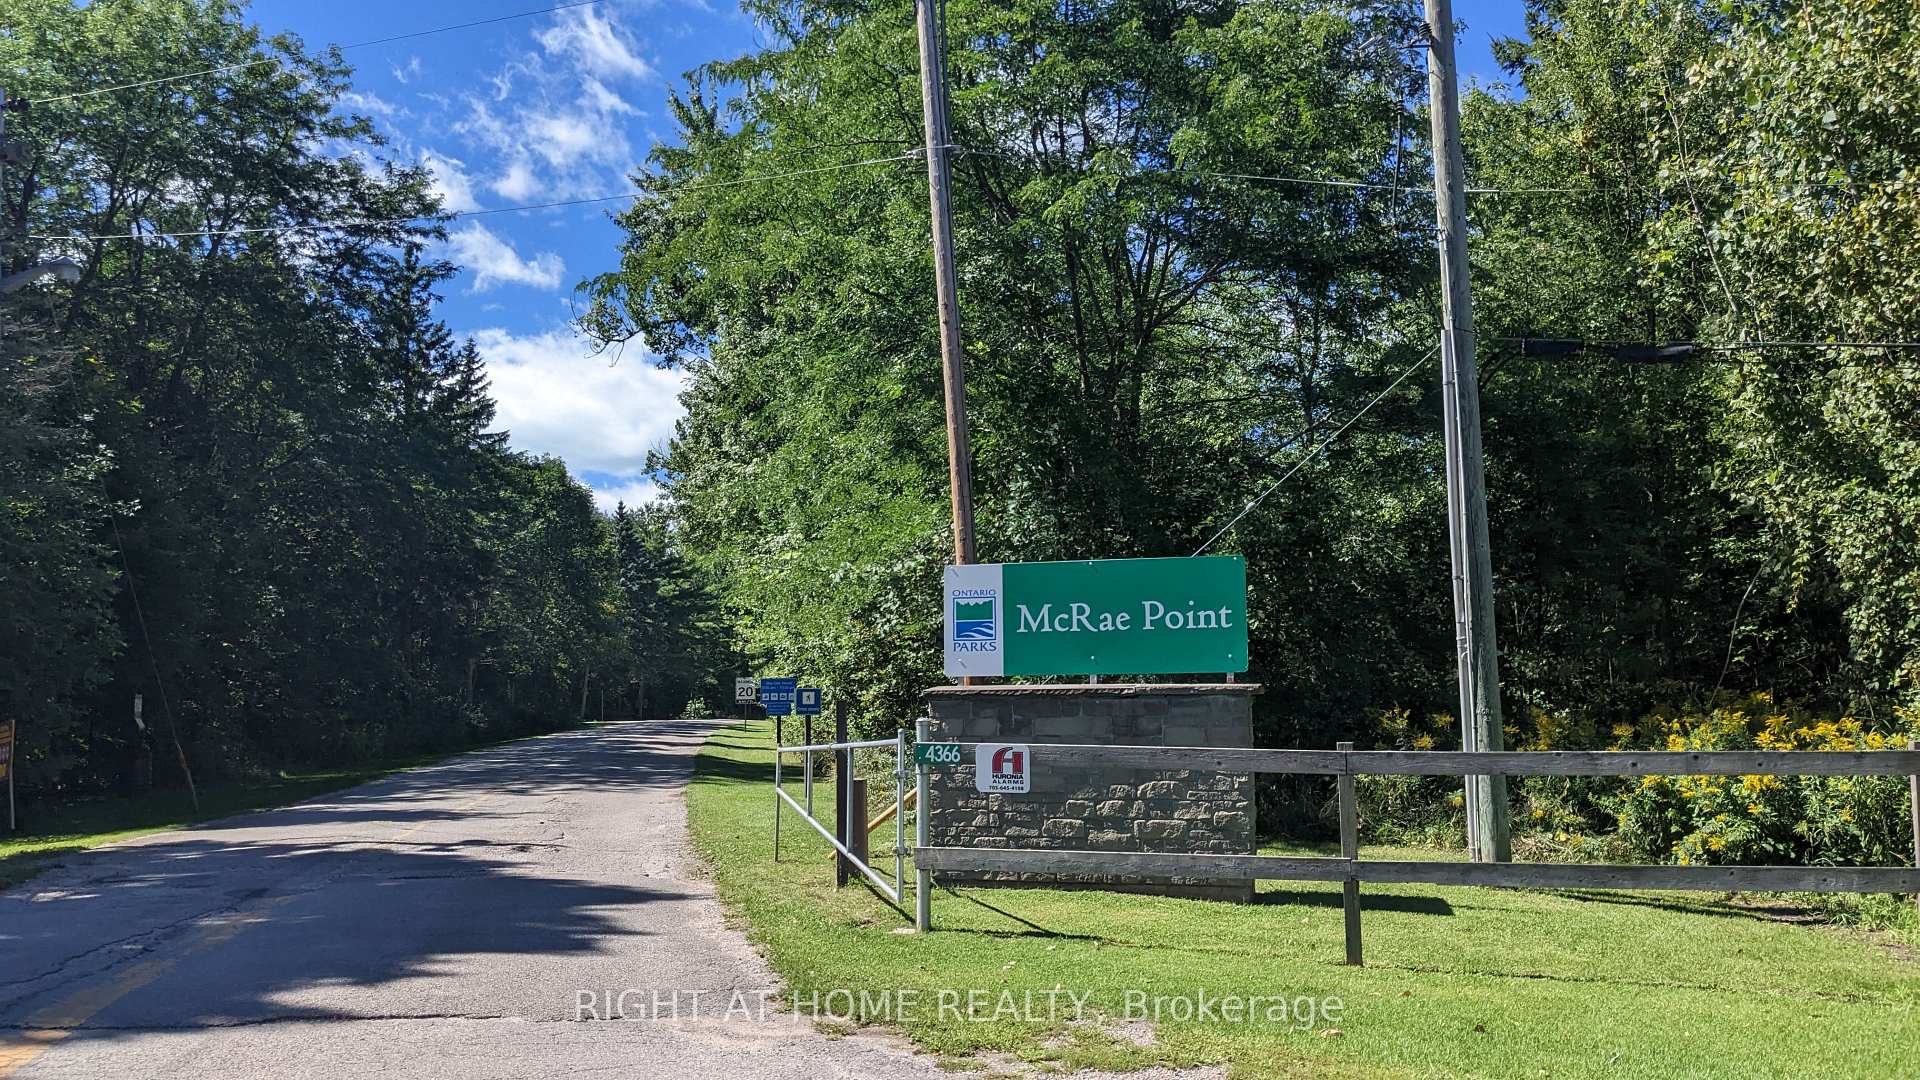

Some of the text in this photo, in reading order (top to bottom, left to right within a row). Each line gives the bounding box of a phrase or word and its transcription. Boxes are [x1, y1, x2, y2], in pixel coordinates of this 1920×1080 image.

[952, 589, 997, 597] ONTARIO
[1016, 600, 1233, 633] McRae Point
[953, 641, 997, 652] PARKS
[738, 686, 753, 697] 20
[925, 745, 961, 763] 4366
